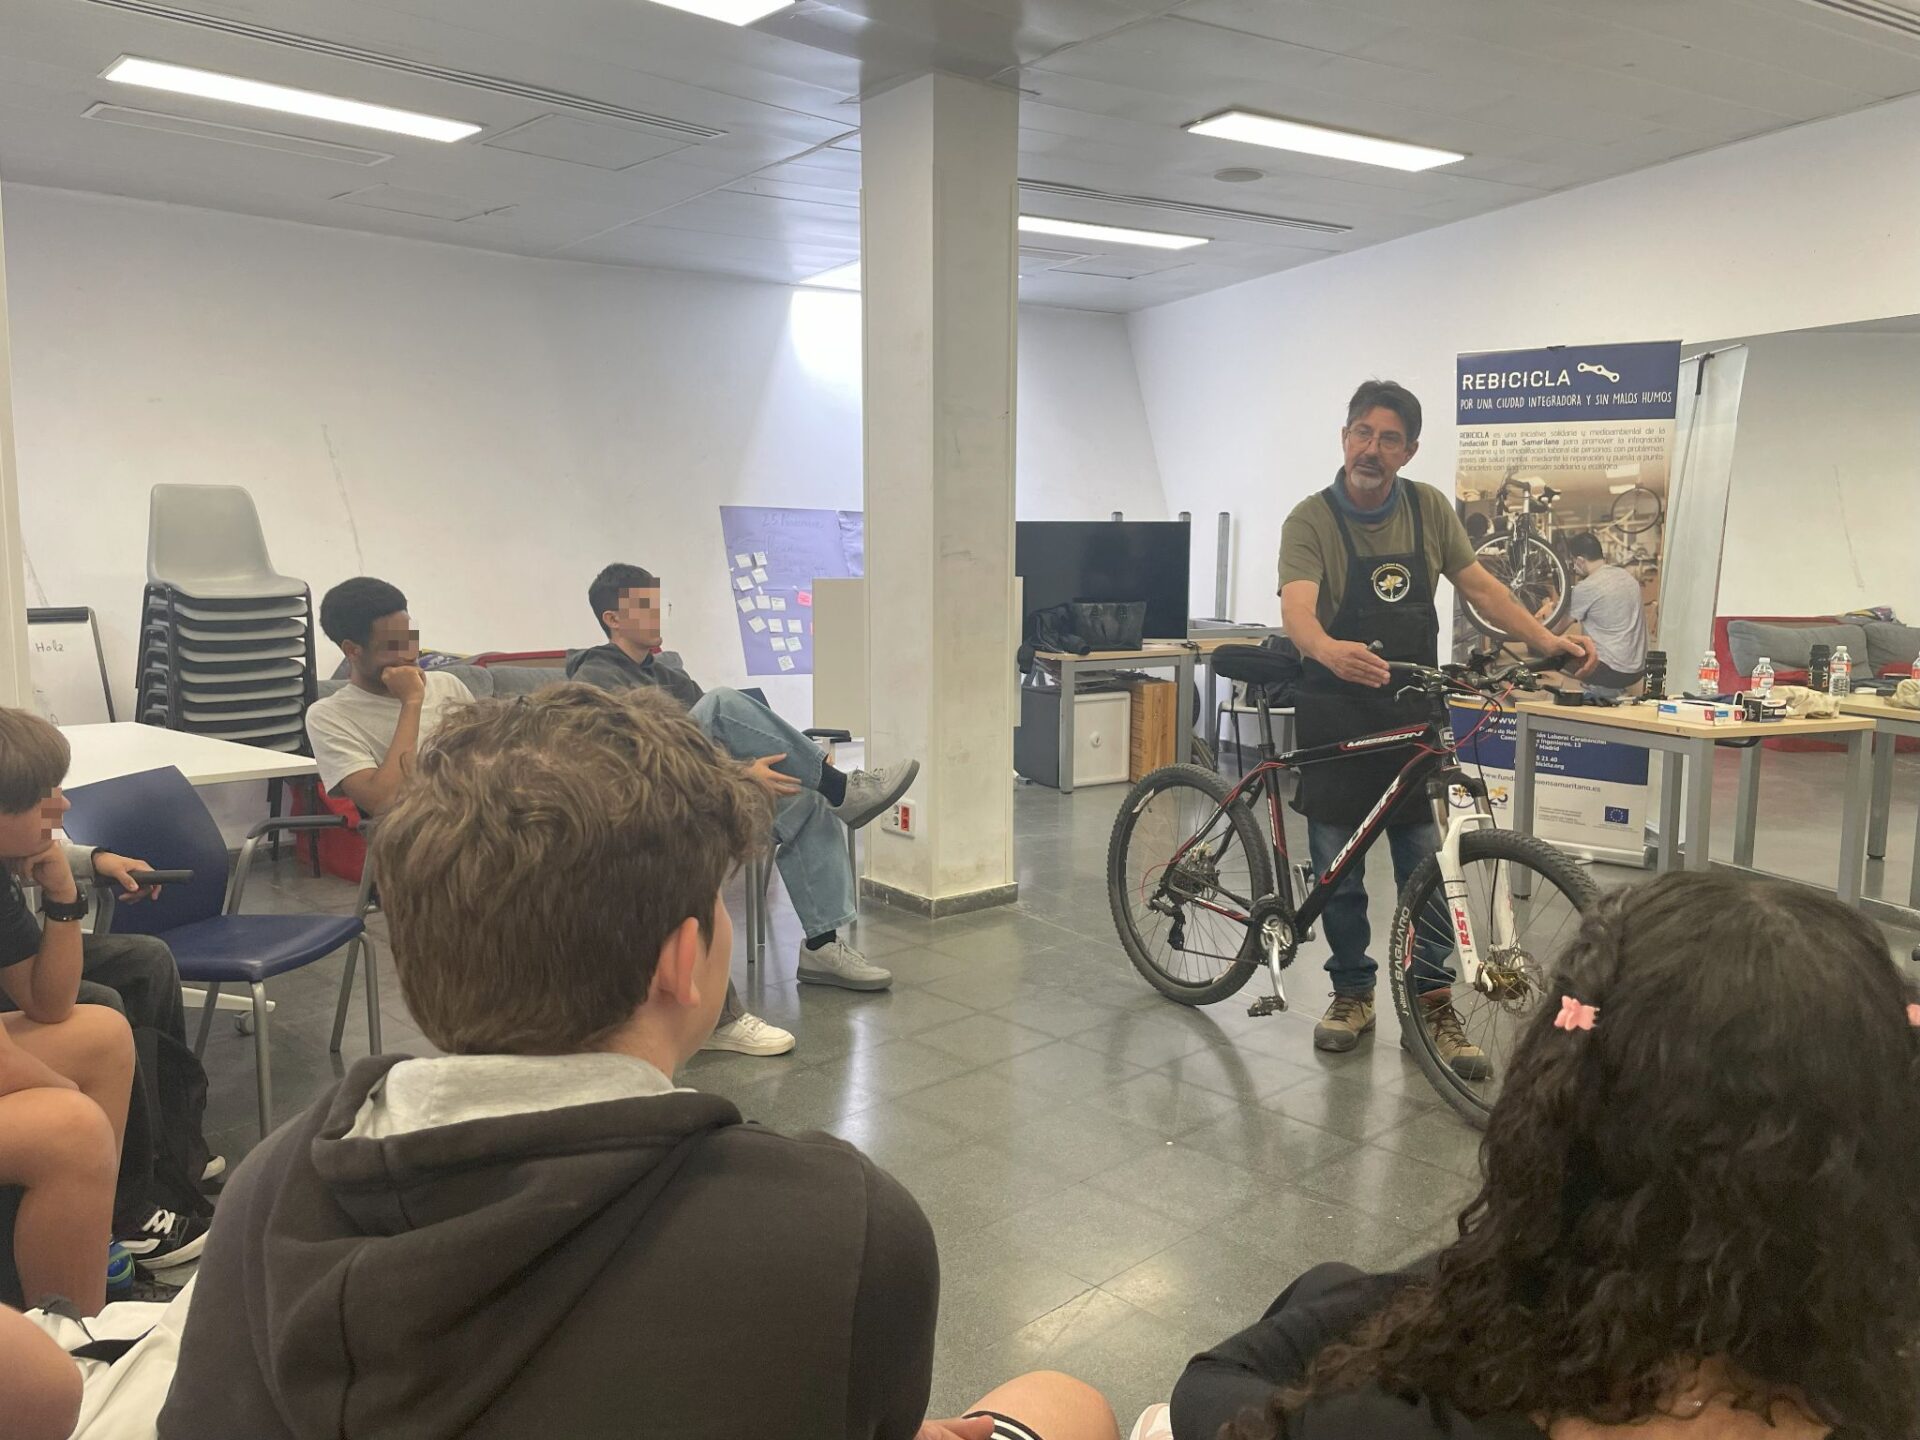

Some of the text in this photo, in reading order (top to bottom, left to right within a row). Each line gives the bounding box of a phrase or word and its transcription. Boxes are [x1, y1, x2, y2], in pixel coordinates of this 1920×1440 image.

[1462, 369, 1571, 390] REBICICLA
[1460, 391, 1672, 411] POR UNA CIUDAD INTEGRADORA Y SIN MALOS HUMOS
[1501, 438, 1518, 446] Buen
[1346, 730, 1425, 748] MISSION
[1539, 744, 1560, 752] Madrid
[1455, 908, 1471, 946] RST
[1394, 906, 1410, 982] SAGUARO
